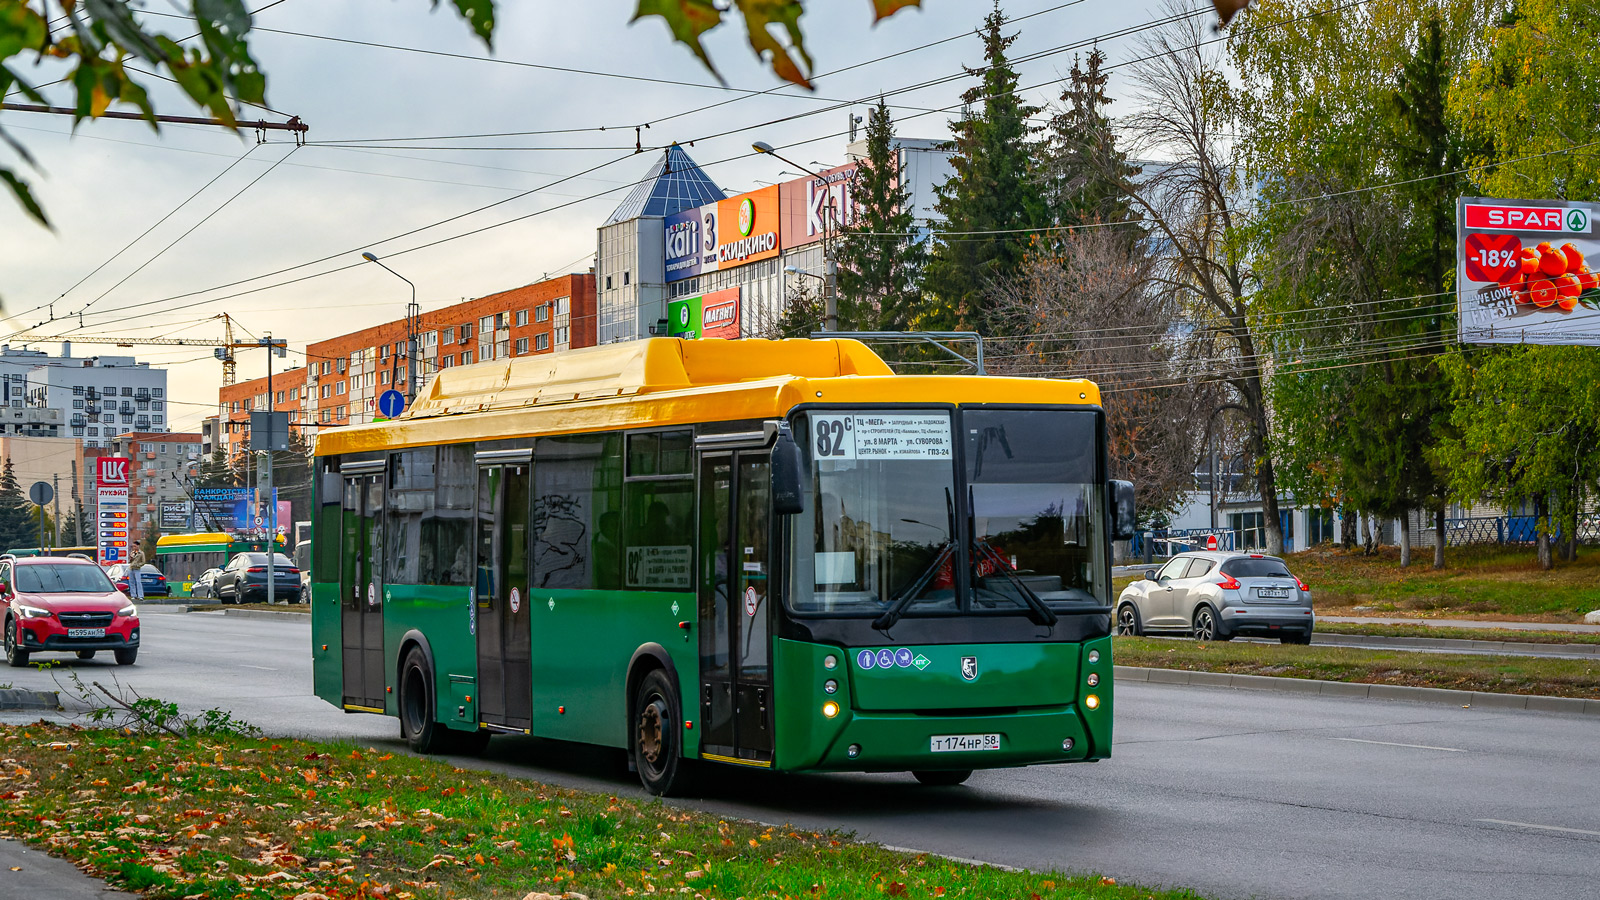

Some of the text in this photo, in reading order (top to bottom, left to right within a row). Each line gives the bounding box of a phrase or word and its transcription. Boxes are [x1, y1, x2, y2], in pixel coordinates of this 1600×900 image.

[1488, 210, 1561, 227] SPAR
[665, 221, 697, 260] kari
[705, 213, 715, 252] 3
[719, 232, 775, 262] СКИДКИНО
[1470, 249, 1517, 268] -18%
[1490, 286, 1512, 303] LOVE
[704, 306, 735, 324] МАГНИТ
[1470, 298, 1518, 325] FRESH
[856, 418, 865, 426] ТЦ
[916, 437, 943, 445] СУВОРОВА
[928, 448, 949, 456] ГПЗ-24
[985, 735, 996, 745] 58
